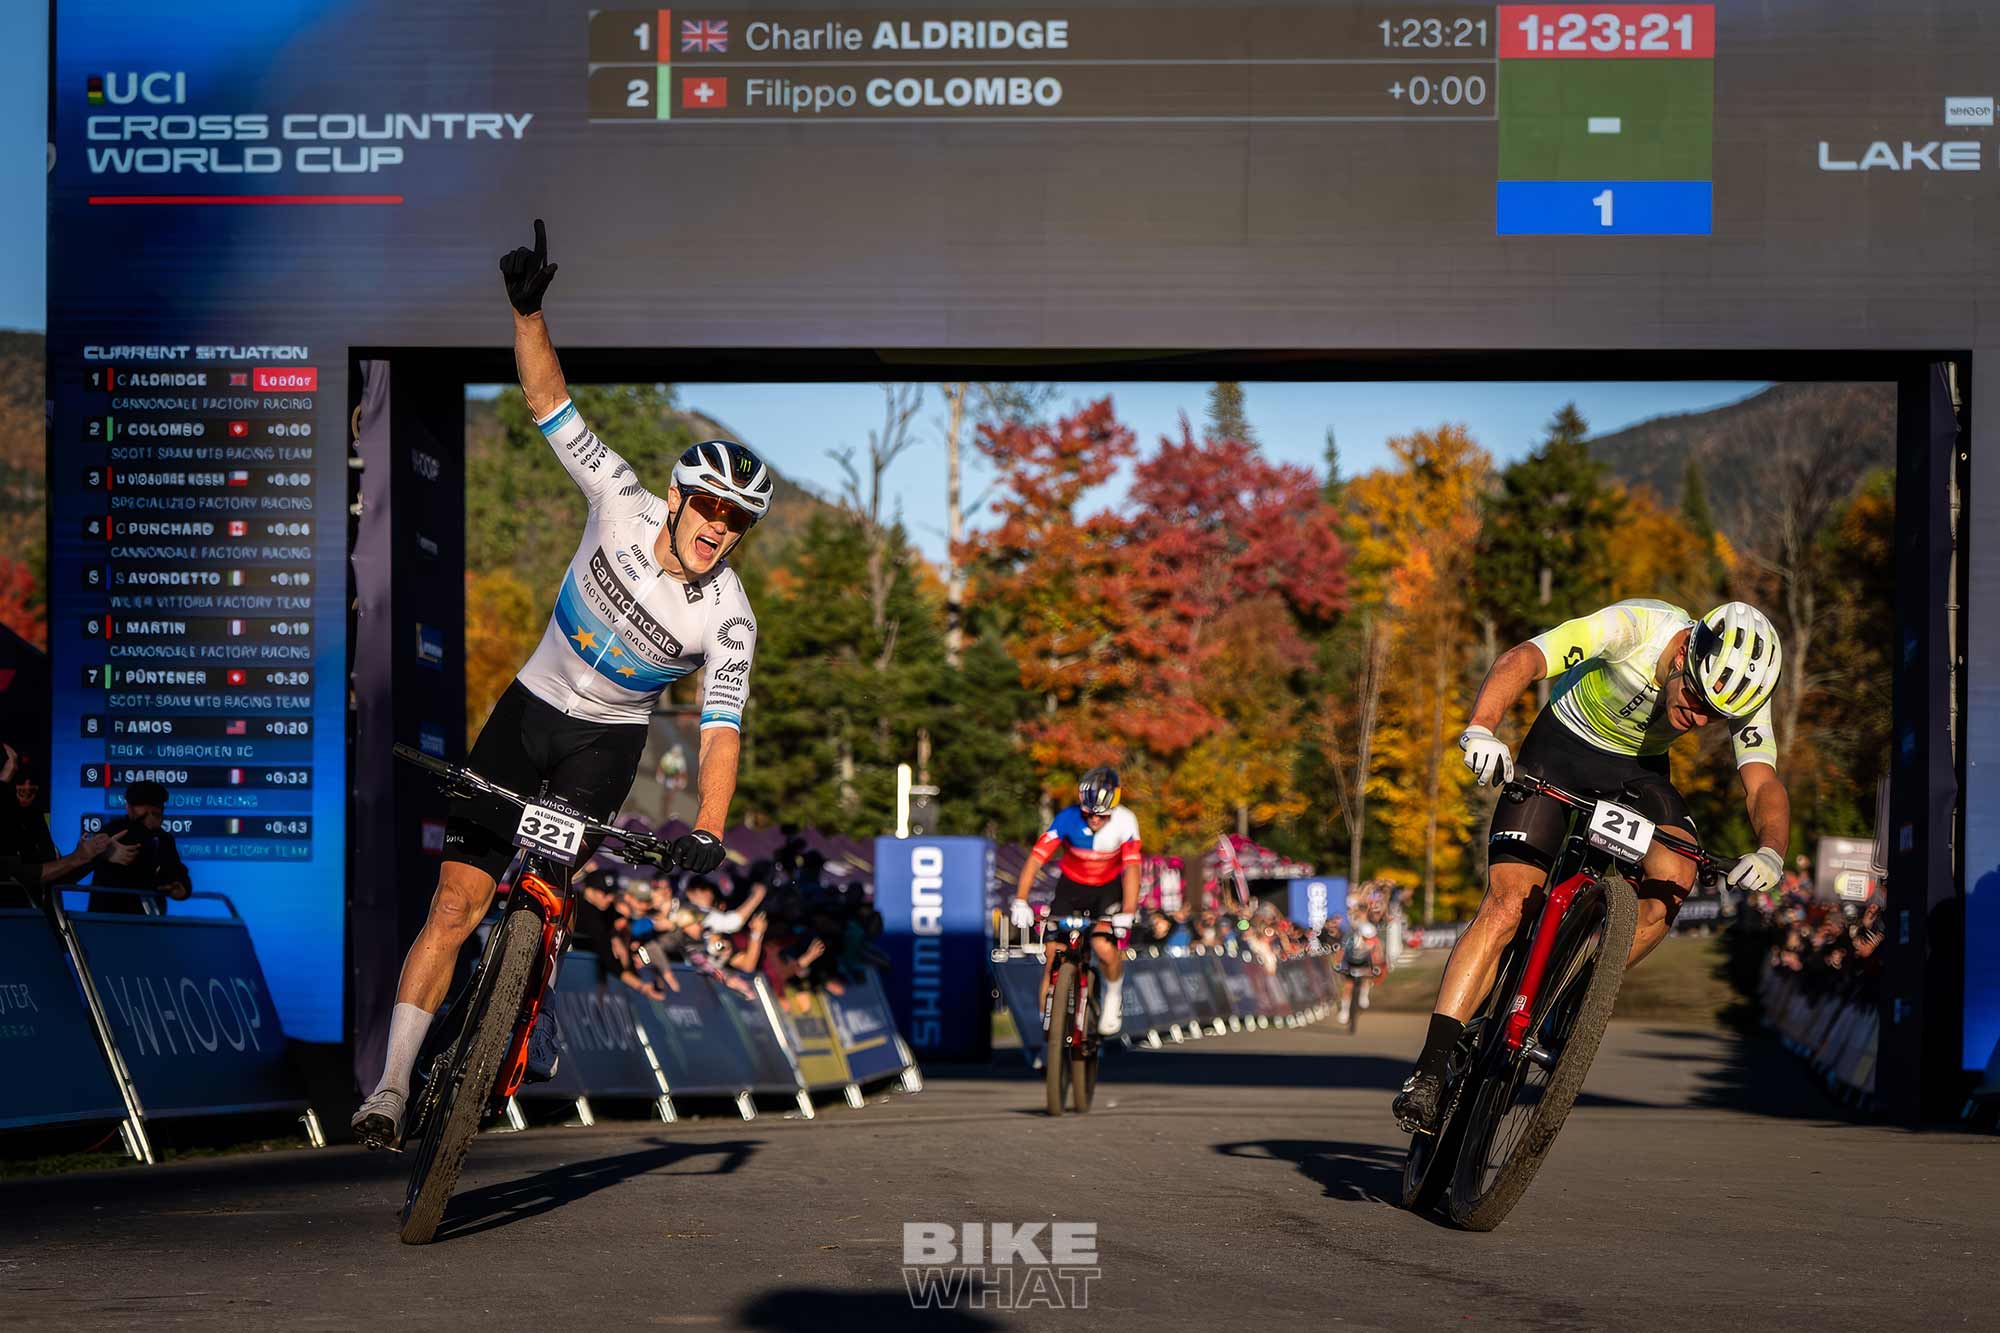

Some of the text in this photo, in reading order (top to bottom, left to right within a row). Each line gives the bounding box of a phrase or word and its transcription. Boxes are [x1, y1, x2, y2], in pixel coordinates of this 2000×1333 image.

[633, 20, 1069, 52] 1 Charlie ALDRIDGE
[1379, 19, 1488, 48] 1:23:21
[1518, 14, 1694, 51] 1:23:21
[106, 71, 186, 104] UCI
[627, 77, 1063, 112] 2 Filippo COLOMBO
[1387, 75, 1486, 106] +0:00
[87, 113, 534, 141] CROSS COUNTRY
[87, 147, 403, 173] WORLD CUP
[1817, 141, 1980, 171] LAKE
[1592, 190, 1614, 225] 1
[84, 346, 308, 359] CURRENT SITUATION
[91, 373, 100, 386] 1
[260, 374, 311, 386] Leader
[90, 422, 100, 436] 2
[128, 423, 205, 436] COLOMBO
[89, 472, 100, 485] 3
[89, 571, 99, 584] 5
[128, 572, 220, 585] AVONDETTO
[592, 557, 680, 656] cannondale
[126, 621, 186, 634] MARTIN
[88, 669, 97, 683] 7
[87, 719, 98, 733] 8
[128, 721, 172, 733] AMOS
[87, 768, 98, 782] 9
[540, 799, 580, 817] WHOOP
[84, 817, 102, 832] 10
[522, 817, 575, 849] 321
[1602, 810, 1640, 841] 21
[912, 846, 943, 1047] SHIMANO
[106, 976, 261, 1055] WHOOP
